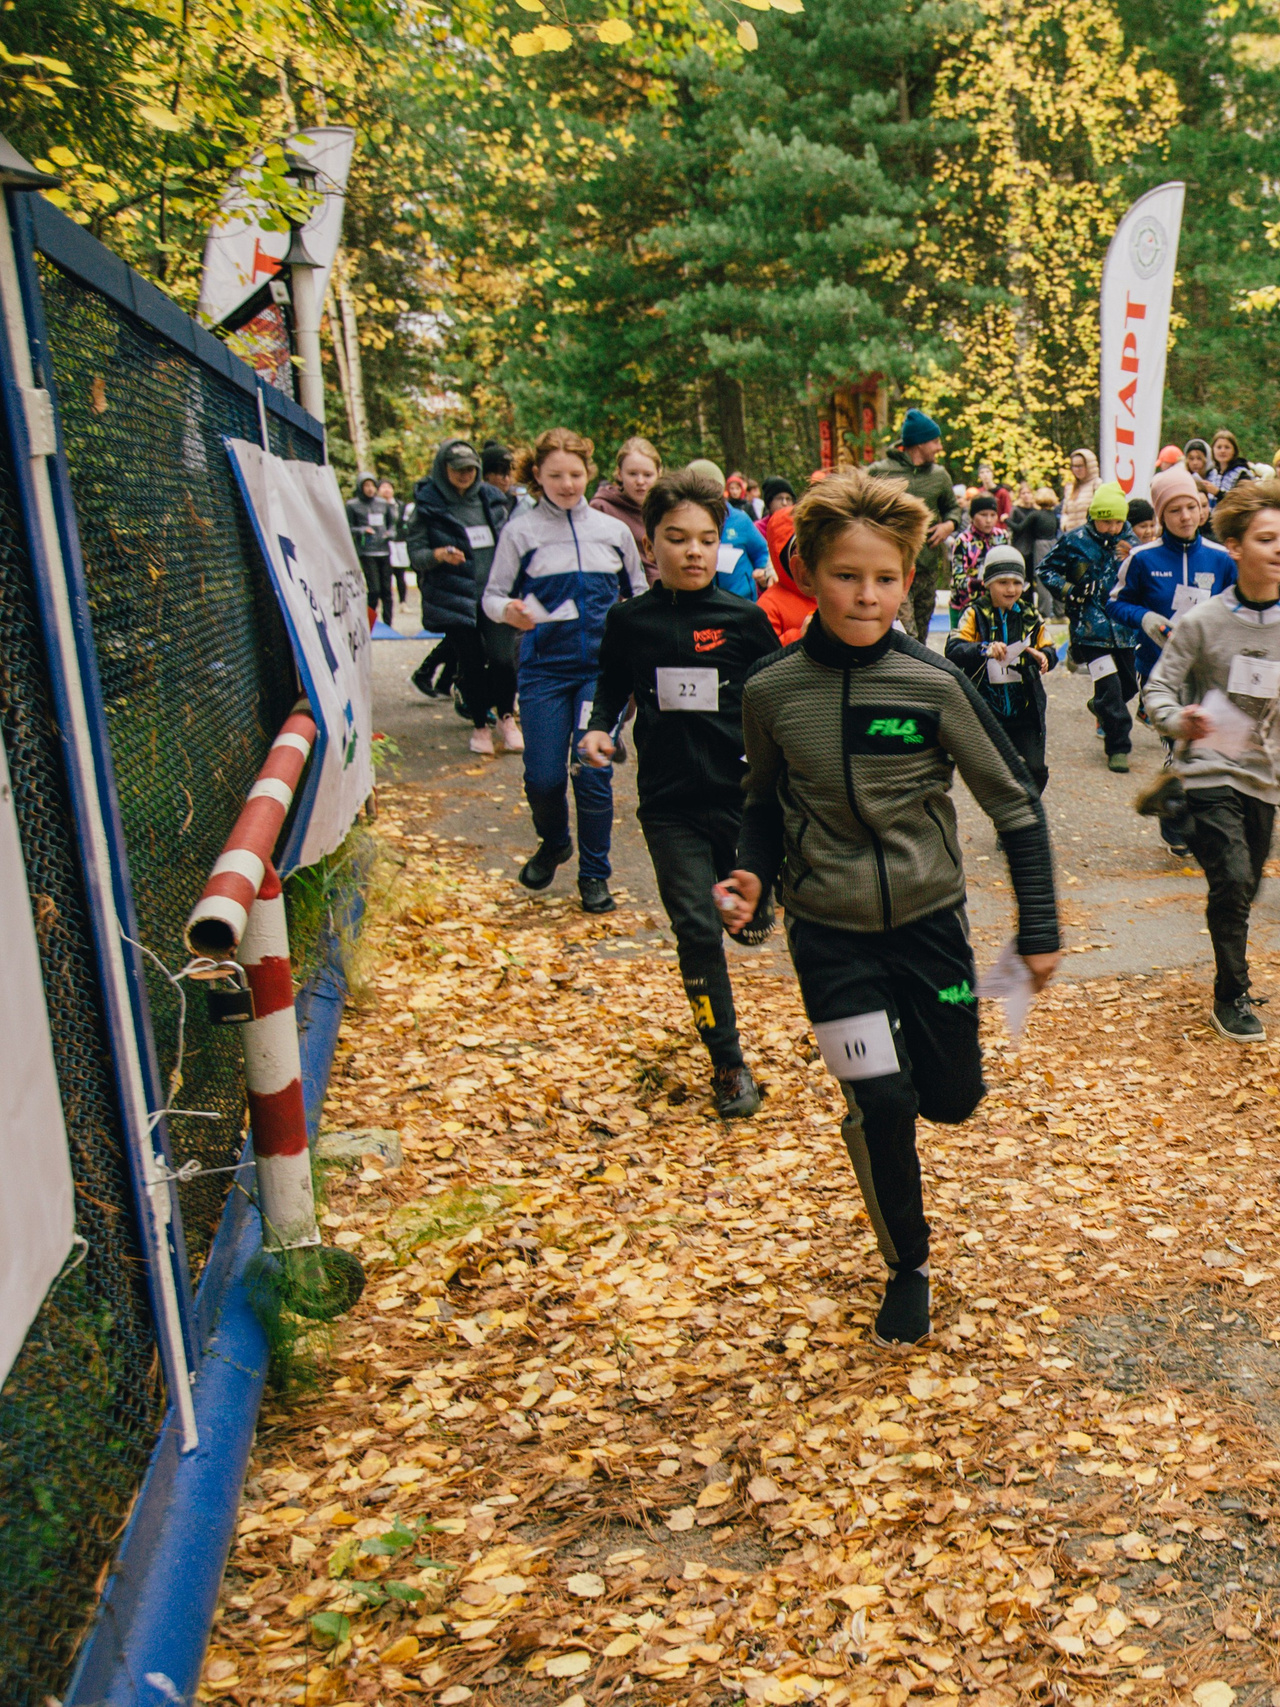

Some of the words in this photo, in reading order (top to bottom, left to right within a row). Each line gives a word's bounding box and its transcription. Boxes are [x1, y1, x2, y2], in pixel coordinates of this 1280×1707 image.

[1114, 289, 1147, 495] СТАРТ
[678, 682, 697, 698] 22
[865, 718, 918, 737] FILA
[843, 1038, 867, 1061] 10
